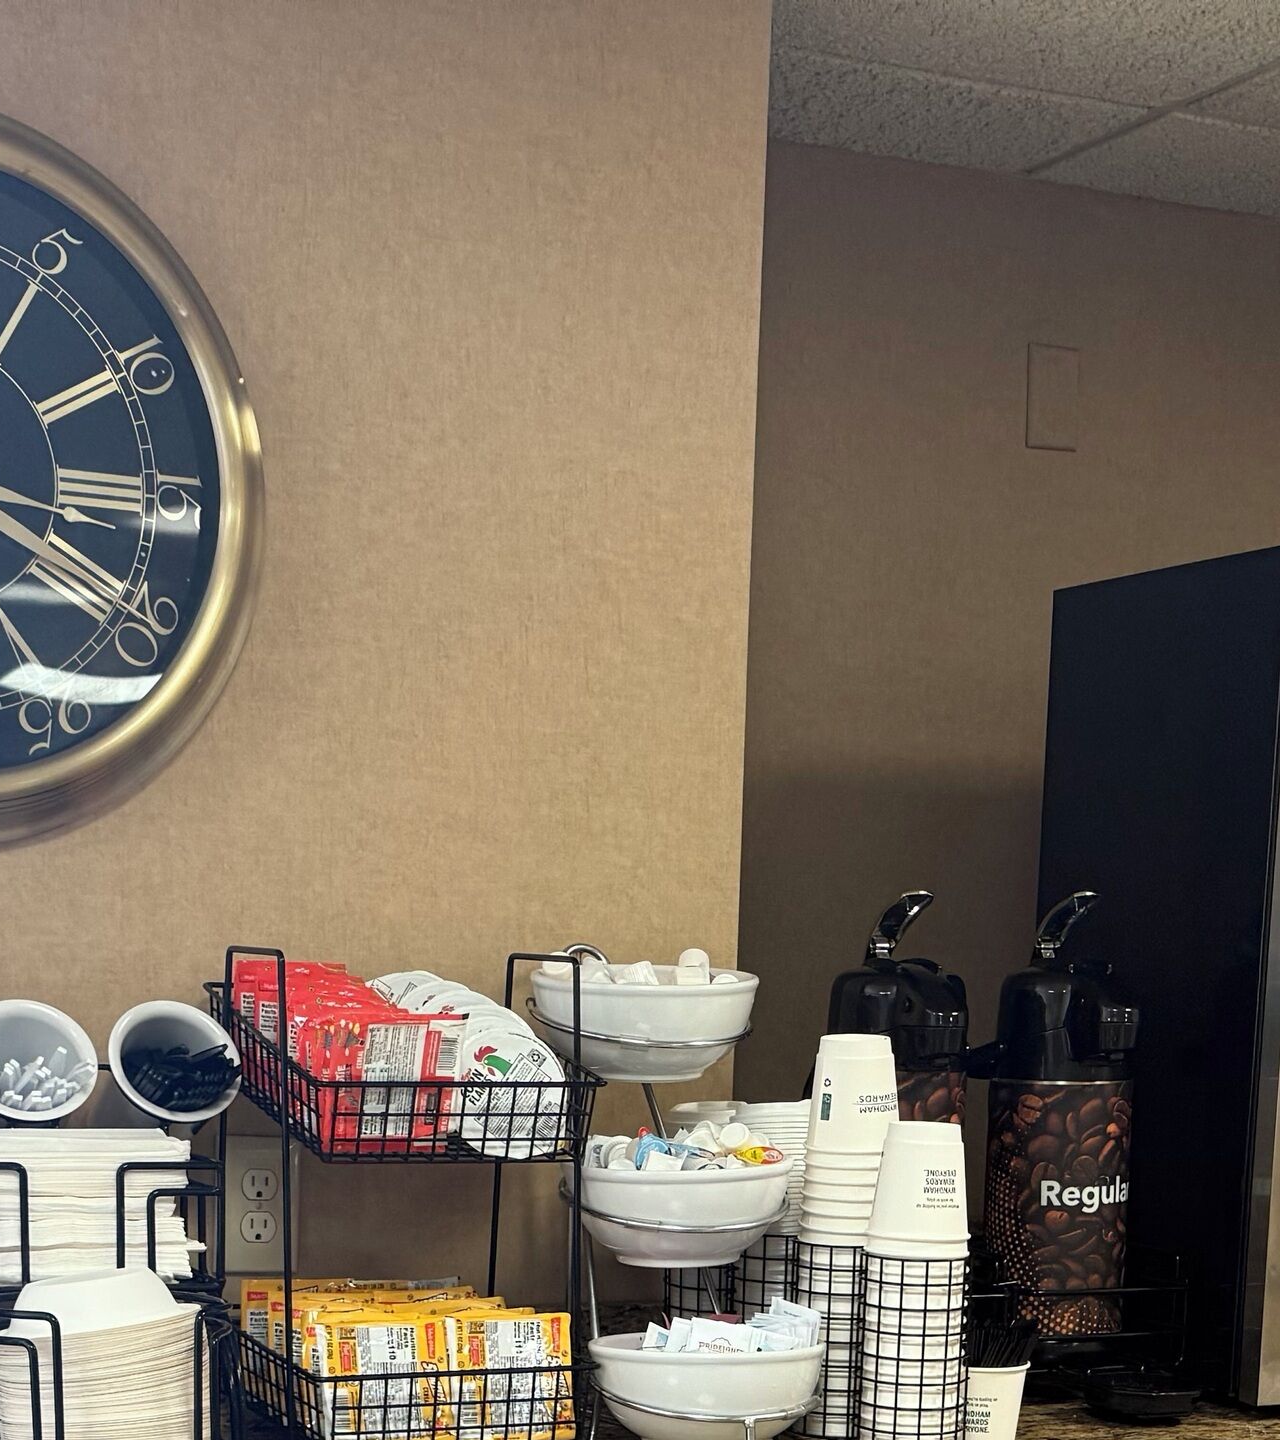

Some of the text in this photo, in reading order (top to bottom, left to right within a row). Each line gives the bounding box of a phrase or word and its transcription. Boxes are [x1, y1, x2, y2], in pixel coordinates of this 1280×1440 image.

[32, 229, 83, 274] 5
[116, 334, 175, 395] 10
[33, 366, 127, 428] II
[56, 463, 144, 517] III
[156, 469, 203, 530] 15
[115, 581, 179, 667] 20
[461, 1067, 485, 1099] CON
[923, 1186, 957, 1194] WYNDHAM
[925, 1177, 956, 1186] REWARDS
